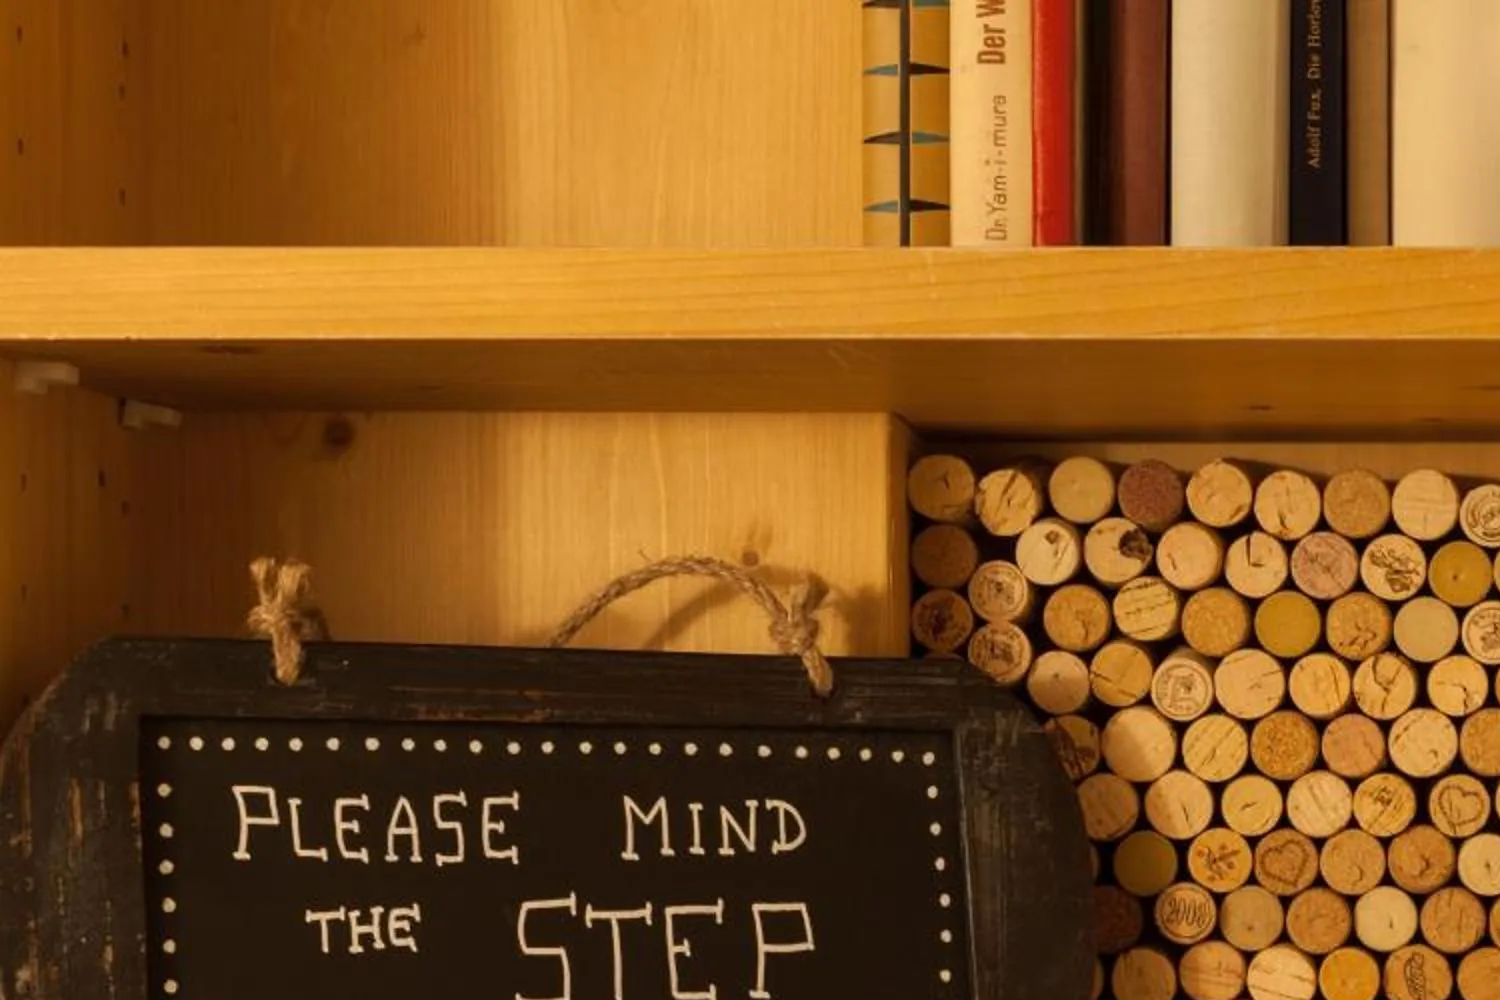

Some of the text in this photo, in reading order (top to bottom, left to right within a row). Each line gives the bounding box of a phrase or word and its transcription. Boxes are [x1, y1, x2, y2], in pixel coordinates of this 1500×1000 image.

[977, 23, 1006, 65] Der
[1307, 53, 1321, 80] Die
[1307, 125, 1321, 168] Adolf
[233, 785, 807, 865] PLEASE MIND
[306, 903, 421, 953] THE
